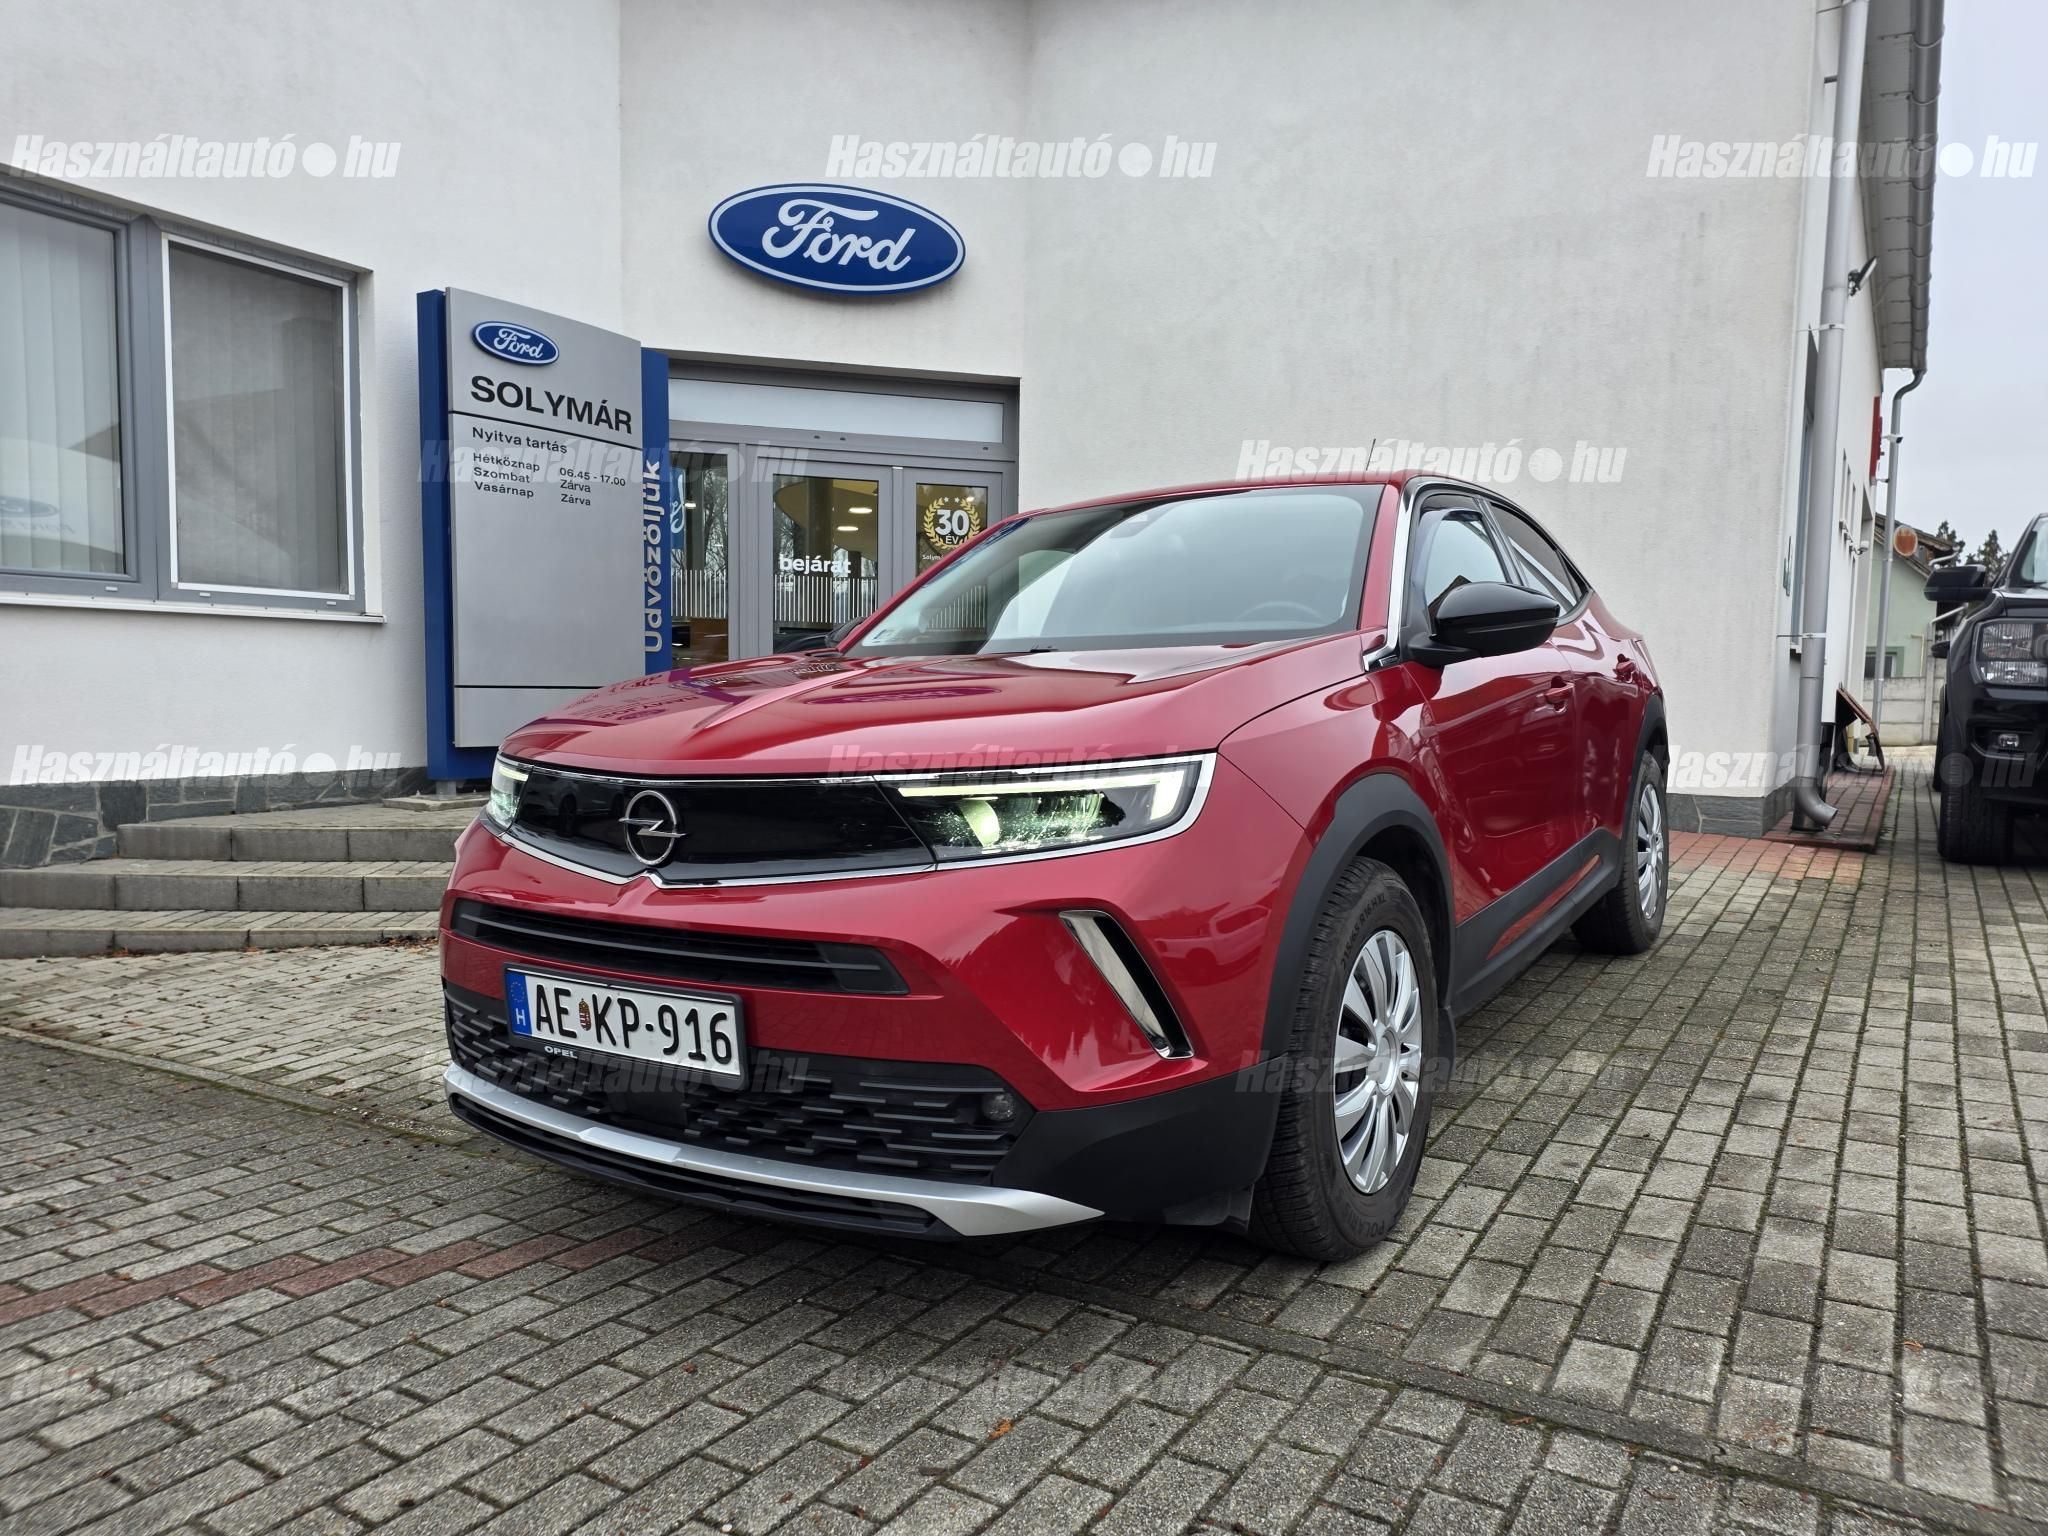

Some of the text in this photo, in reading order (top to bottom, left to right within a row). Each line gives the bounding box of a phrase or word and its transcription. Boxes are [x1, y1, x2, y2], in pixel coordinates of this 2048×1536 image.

[761, 198, 916, 272] Ford
[493, 327, 544, 359] Ford
[471, 375, 633, 434] SOLYMÁR
[472, 427, 568, 454] Nyitva tartás
[473, 453, 540, 473] Hétköznap
[559, 467, 591, 481] 06.45
[600, 474, 626, 488] 17.00
[473, 466, 591, 494] Szombat Zárva
[474, 481, 591, 507] Vasárnap Zárva
[935, 509, 970, 536] 30
[945, 533, 959, 545] ÉV
[779, 553, 852, 575] bejárat
[544, 1046, 578, 1059] OPEL
